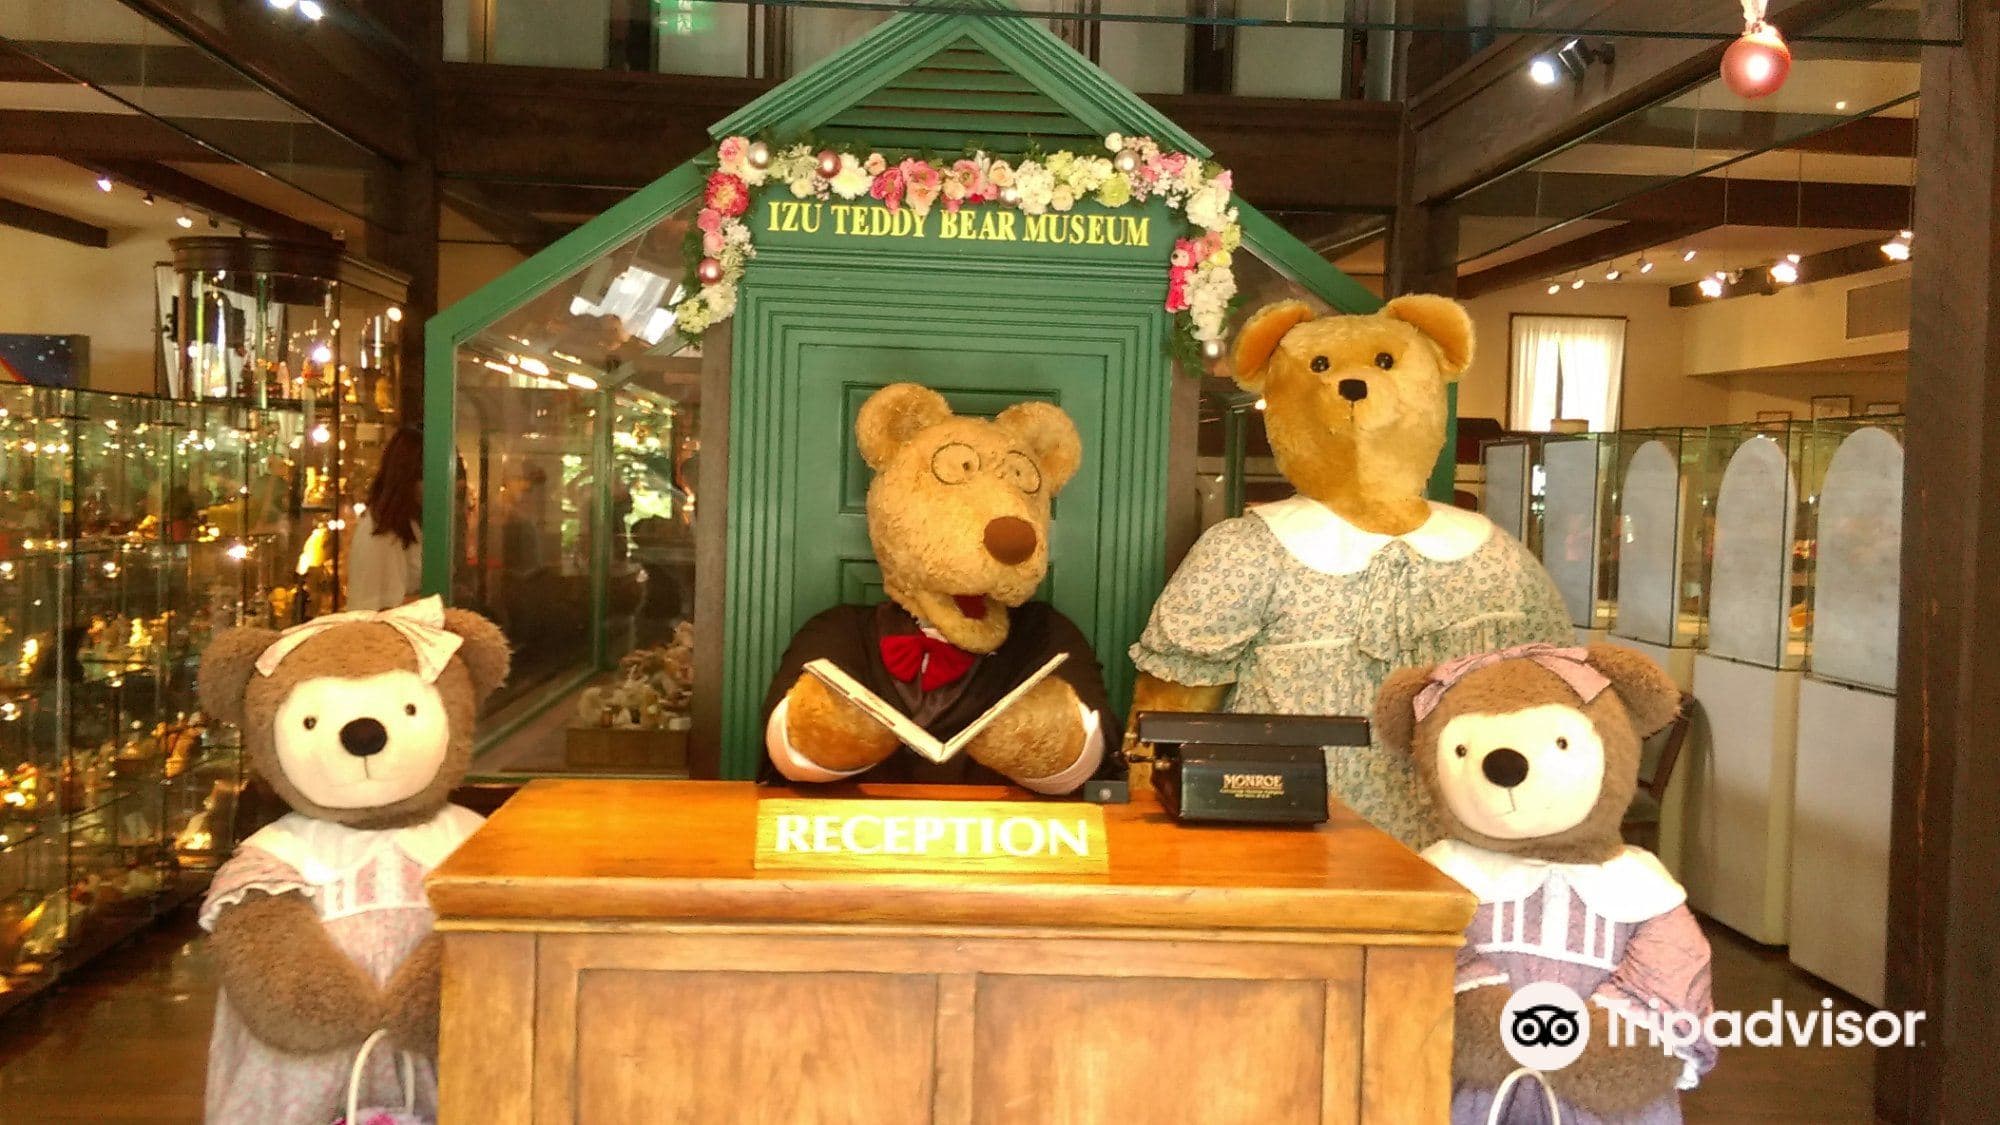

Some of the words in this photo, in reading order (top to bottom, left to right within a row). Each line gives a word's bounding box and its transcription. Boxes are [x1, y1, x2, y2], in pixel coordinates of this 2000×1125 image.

[767, 201, 822, 233] IZU
[830, 205, 928, 238] TEDDY
[938, 209, 1017, 242] BEAR
[1022, 213, 1150, 247] MUSEUM
[1223, 774, 1284, 789] MONROE
[774, 814, 1090, 857] RECEPTION
